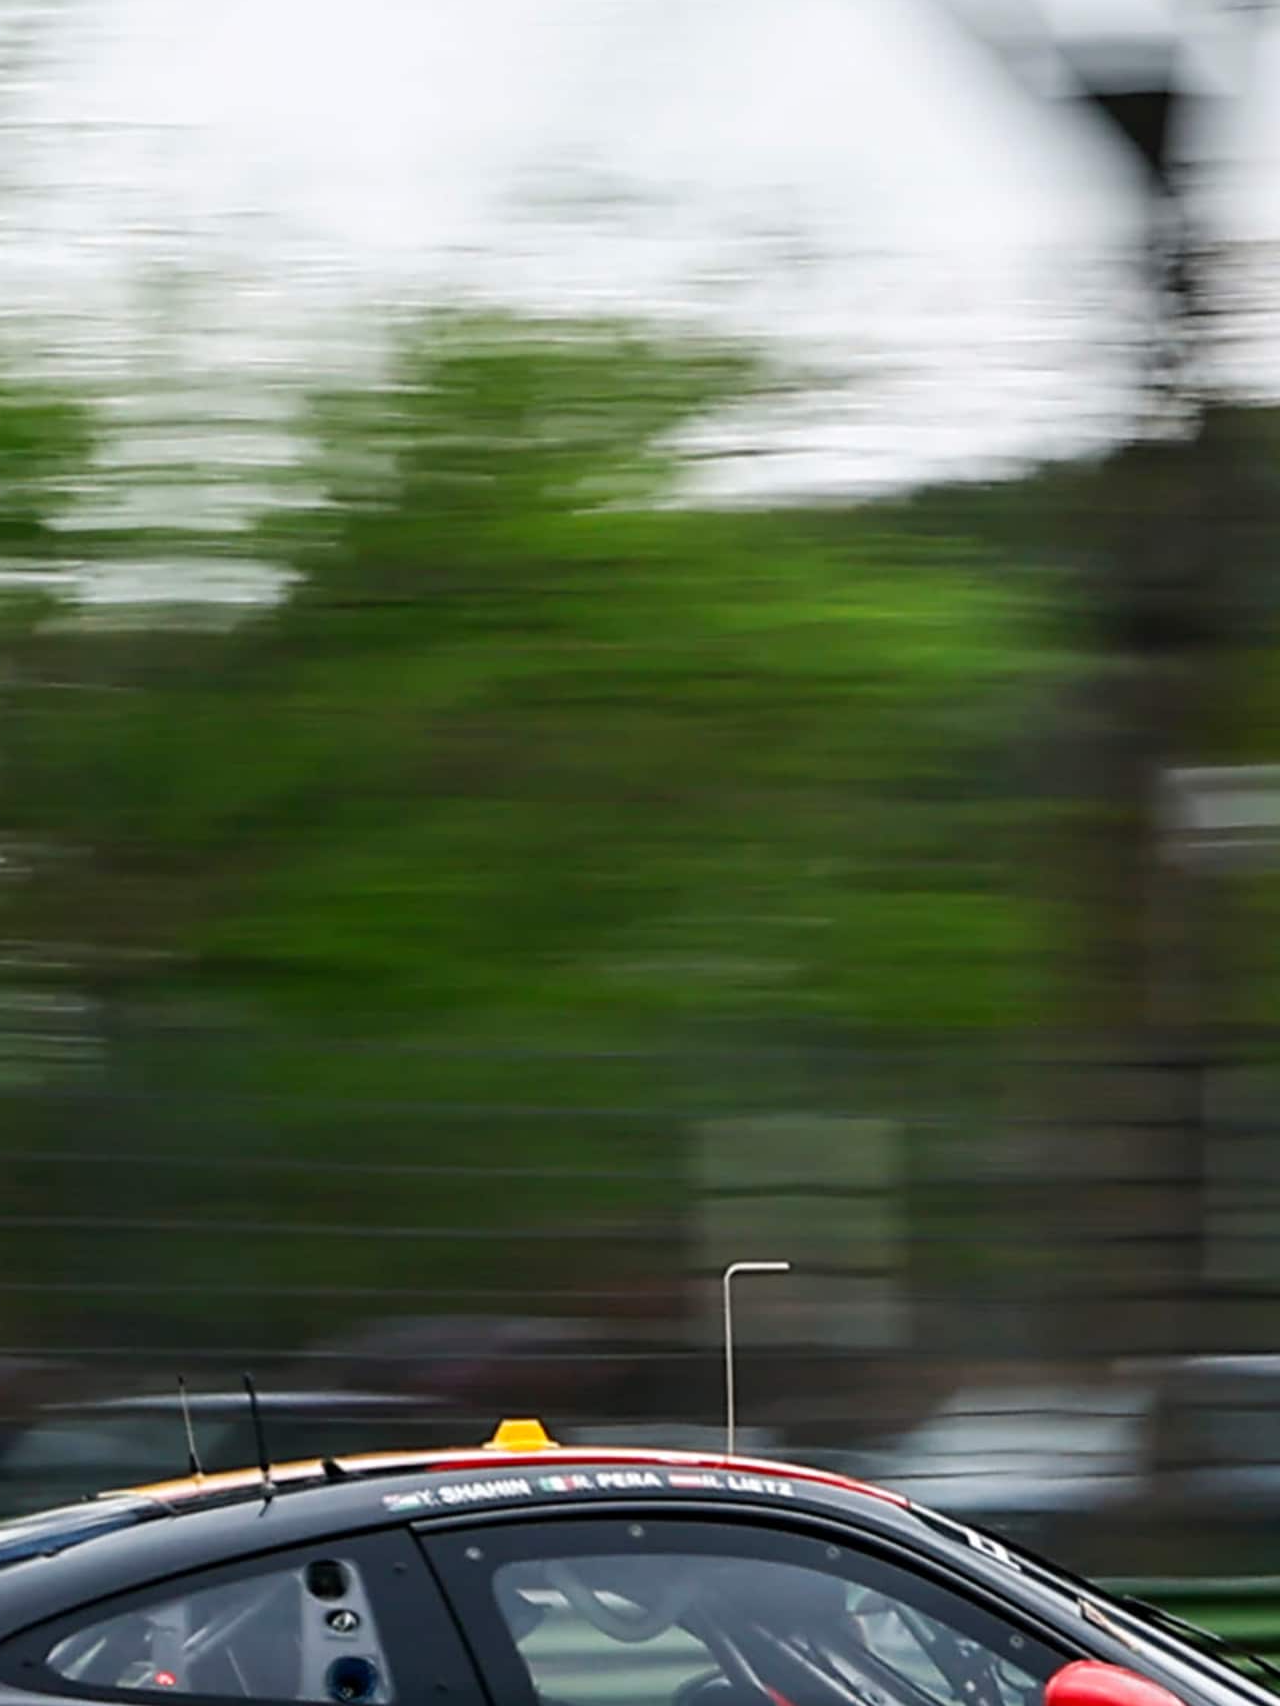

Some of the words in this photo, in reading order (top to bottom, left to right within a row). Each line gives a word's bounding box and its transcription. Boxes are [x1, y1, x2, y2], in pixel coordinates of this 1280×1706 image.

[438, 1478, 532, 1503] SHAHIN
[597, 1471, 663, 1489] PERA
[726, 1476, 794, 1497] LIETZ
